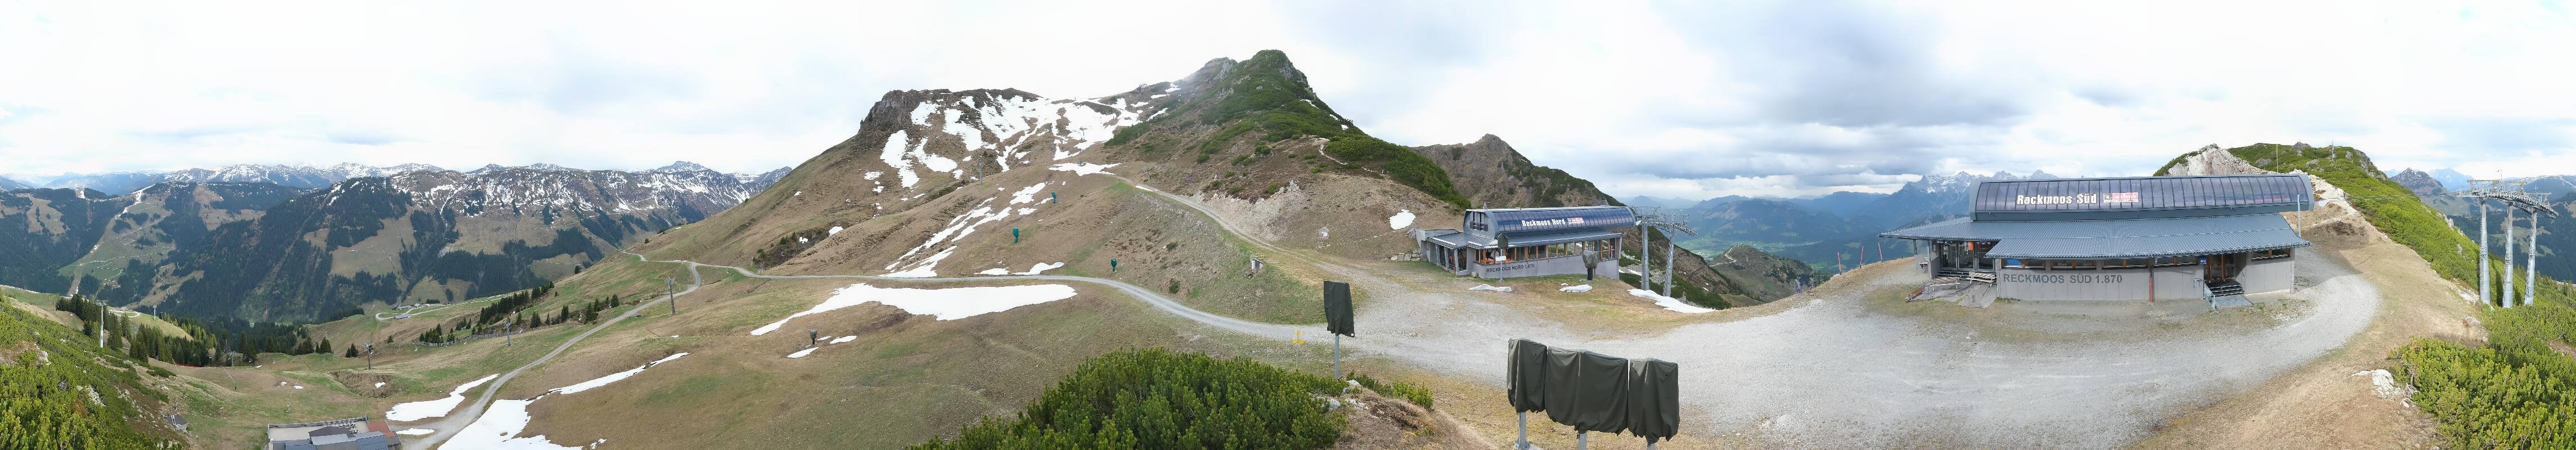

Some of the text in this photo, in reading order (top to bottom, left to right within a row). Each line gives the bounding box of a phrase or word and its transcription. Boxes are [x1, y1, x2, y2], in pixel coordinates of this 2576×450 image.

[2017, 194, 2097, 205] Reckmoos Süd
[2003, 273, 2123, 284] RECKMOOS SÜD 1.870
